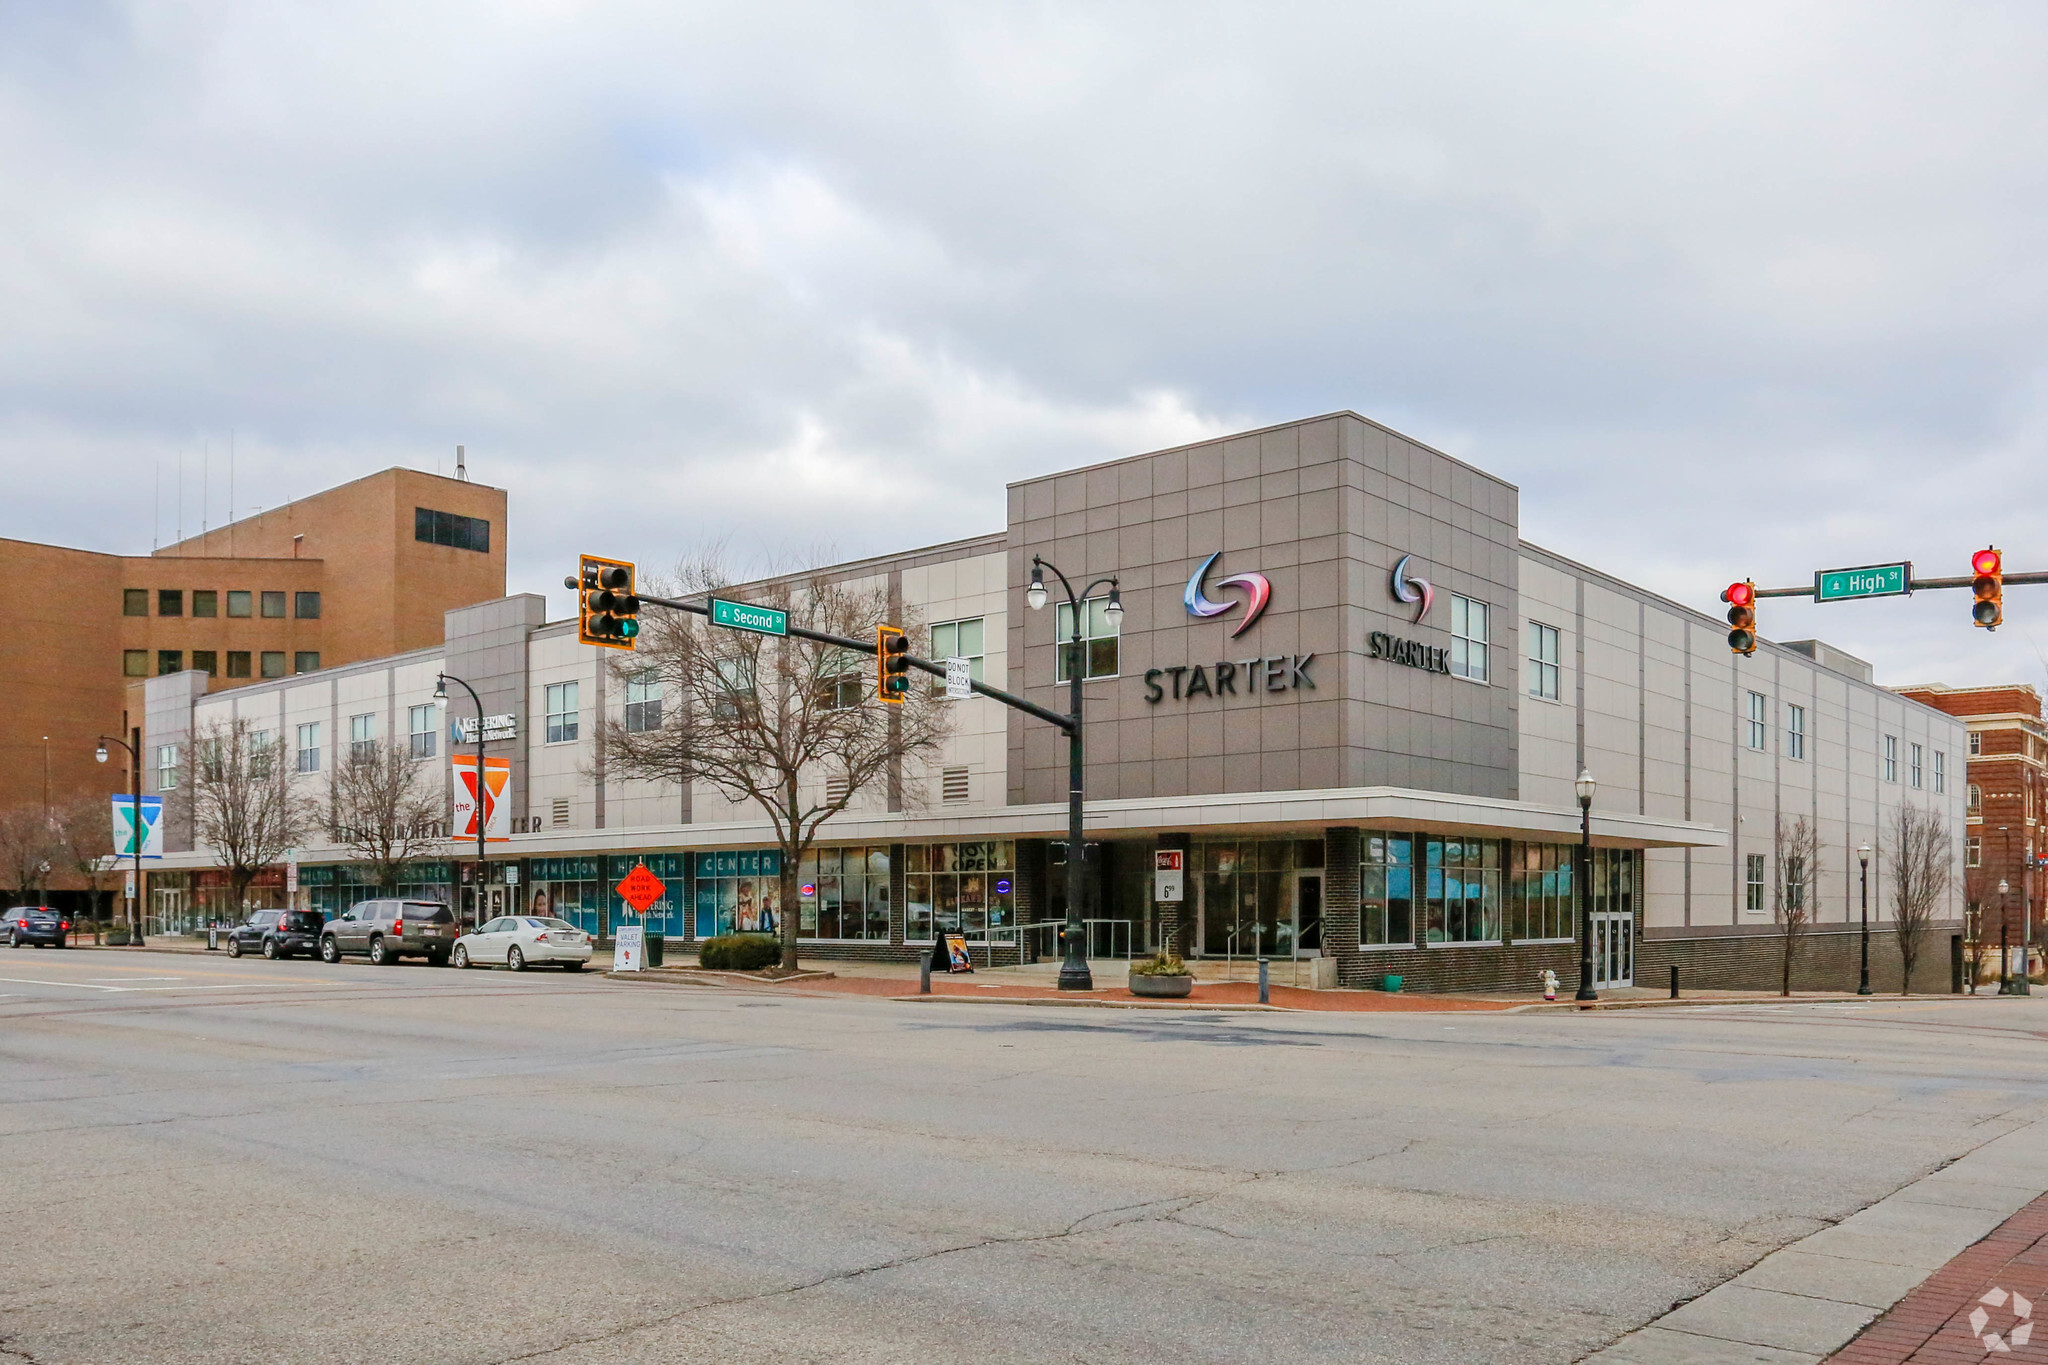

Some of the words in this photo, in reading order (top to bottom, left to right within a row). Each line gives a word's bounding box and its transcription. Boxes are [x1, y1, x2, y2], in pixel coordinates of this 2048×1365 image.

[1849, 573, 1885, 593] High
[1889, 571, 1898, 580] St
[733, 608, 773, 628] Second
[1368, 631, 1450, 675] STARTEK
[948, 662, 956, 671] DO
[957, 664, 969, 674] NOT
[948, 675, 970, 686] BLOCK
[1144, 652, 1316, 703] STARTEK
[455, 802, 471, 813] the
[532, 862, 598, 876] HAMILTON
[617, 860, 677, 873] HELTH
[705, 856, 772, 871] CENTER
[952, 857, 997, 871] OPEN
[620, 933, 638, 941] VALET
[616, 941, 641, 949] PARKING
